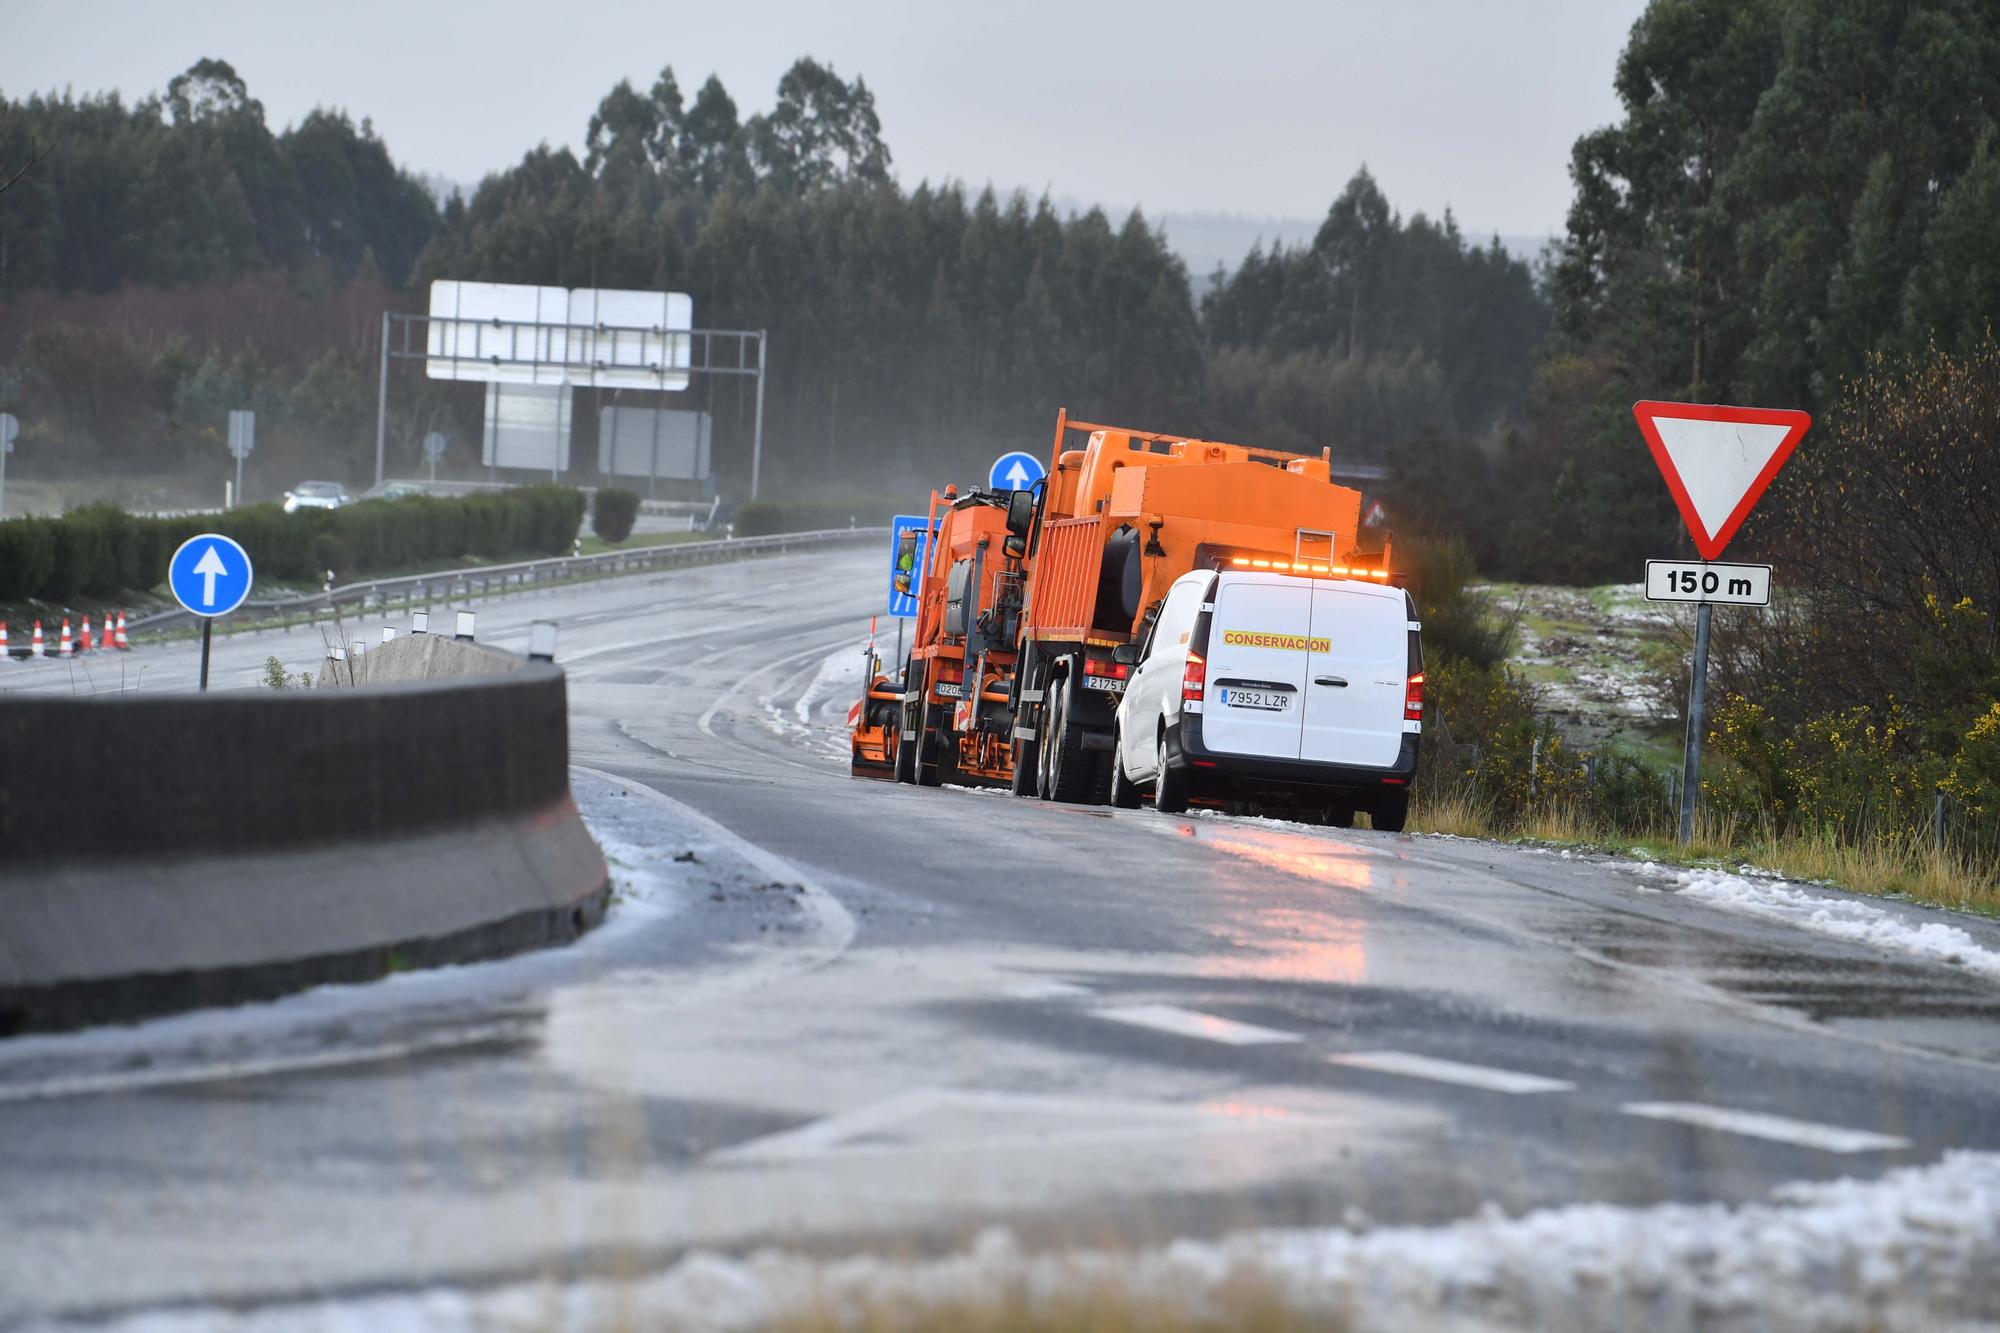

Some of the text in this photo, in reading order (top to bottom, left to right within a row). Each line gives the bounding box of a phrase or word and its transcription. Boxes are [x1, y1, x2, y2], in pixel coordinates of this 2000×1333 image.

[1667, 570, 1752, 596] 150 m
[1224, 632, 1330, 652] CONSERVACIÓN
[1090, 677, 1117, 690] 2175
[1230, 691, 1288, 707] 7952 LZR
